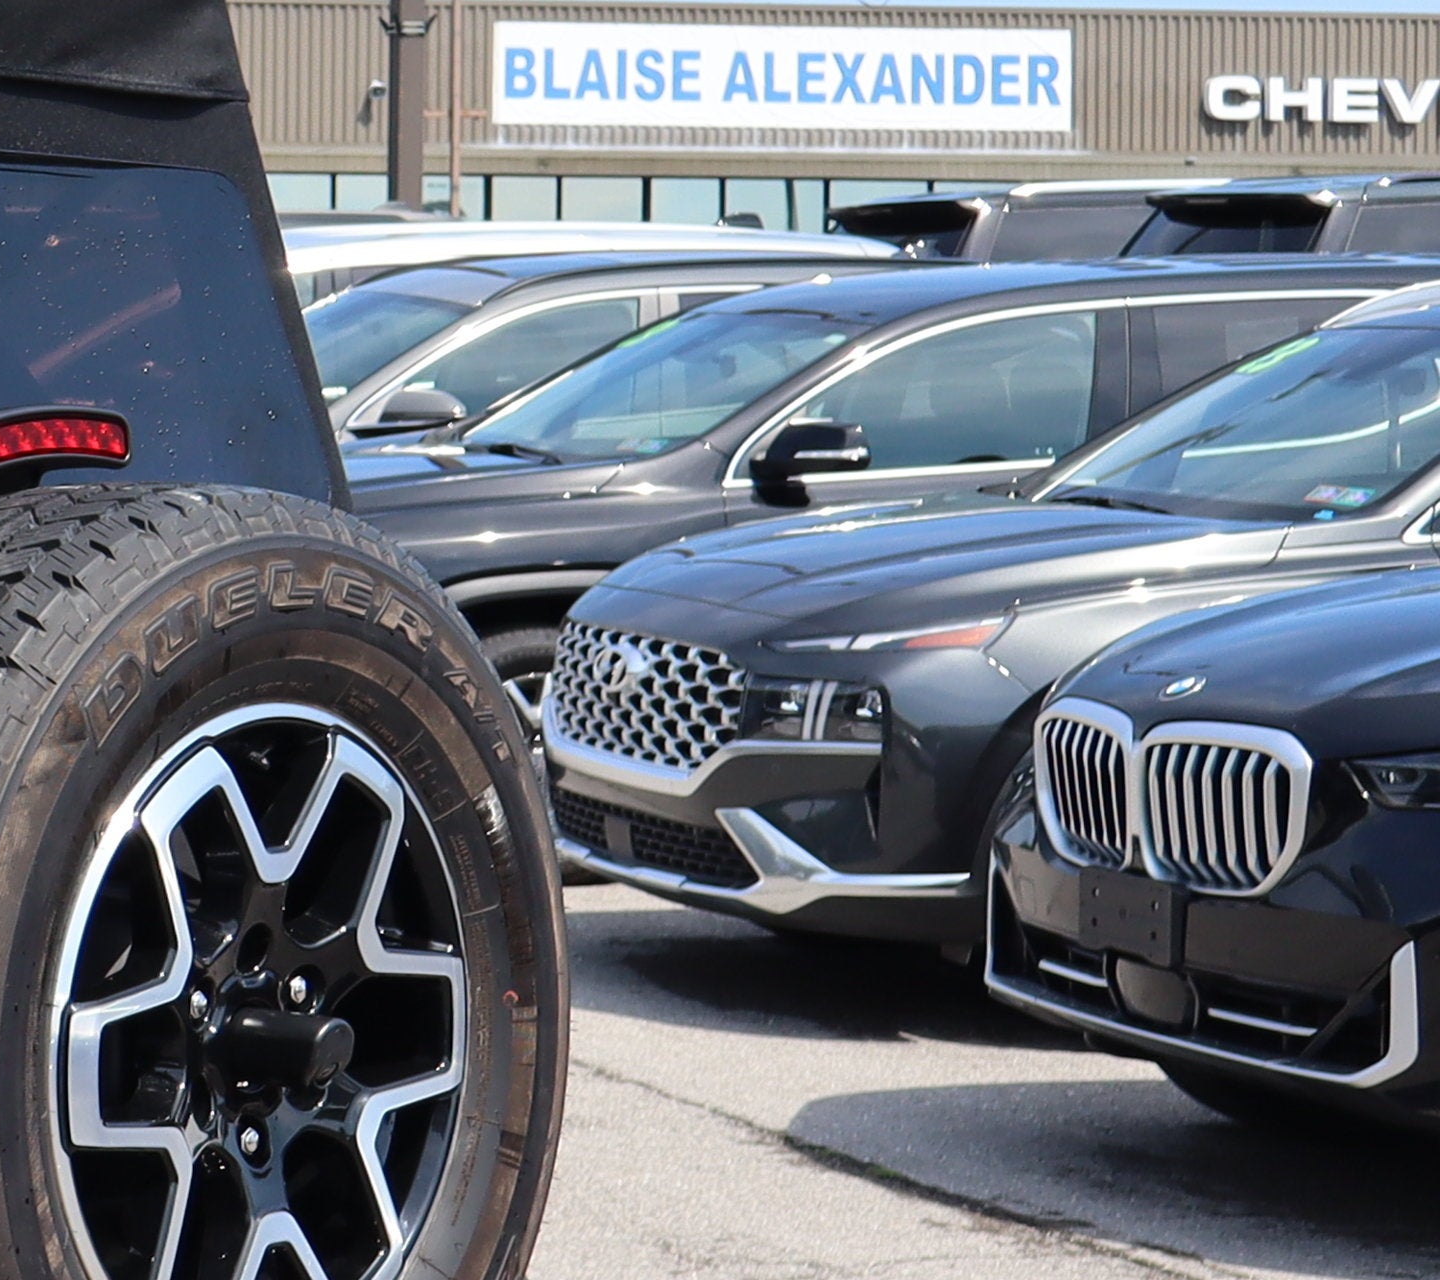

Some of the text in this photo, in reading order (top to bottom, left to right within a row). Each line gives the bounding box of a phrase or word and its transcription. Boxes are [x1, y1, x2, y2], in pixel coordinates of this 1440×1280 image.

[503, 46, 1061, 106] BLAISE ALEXANDER
[1204, 75, 1440, 124] CHEV
